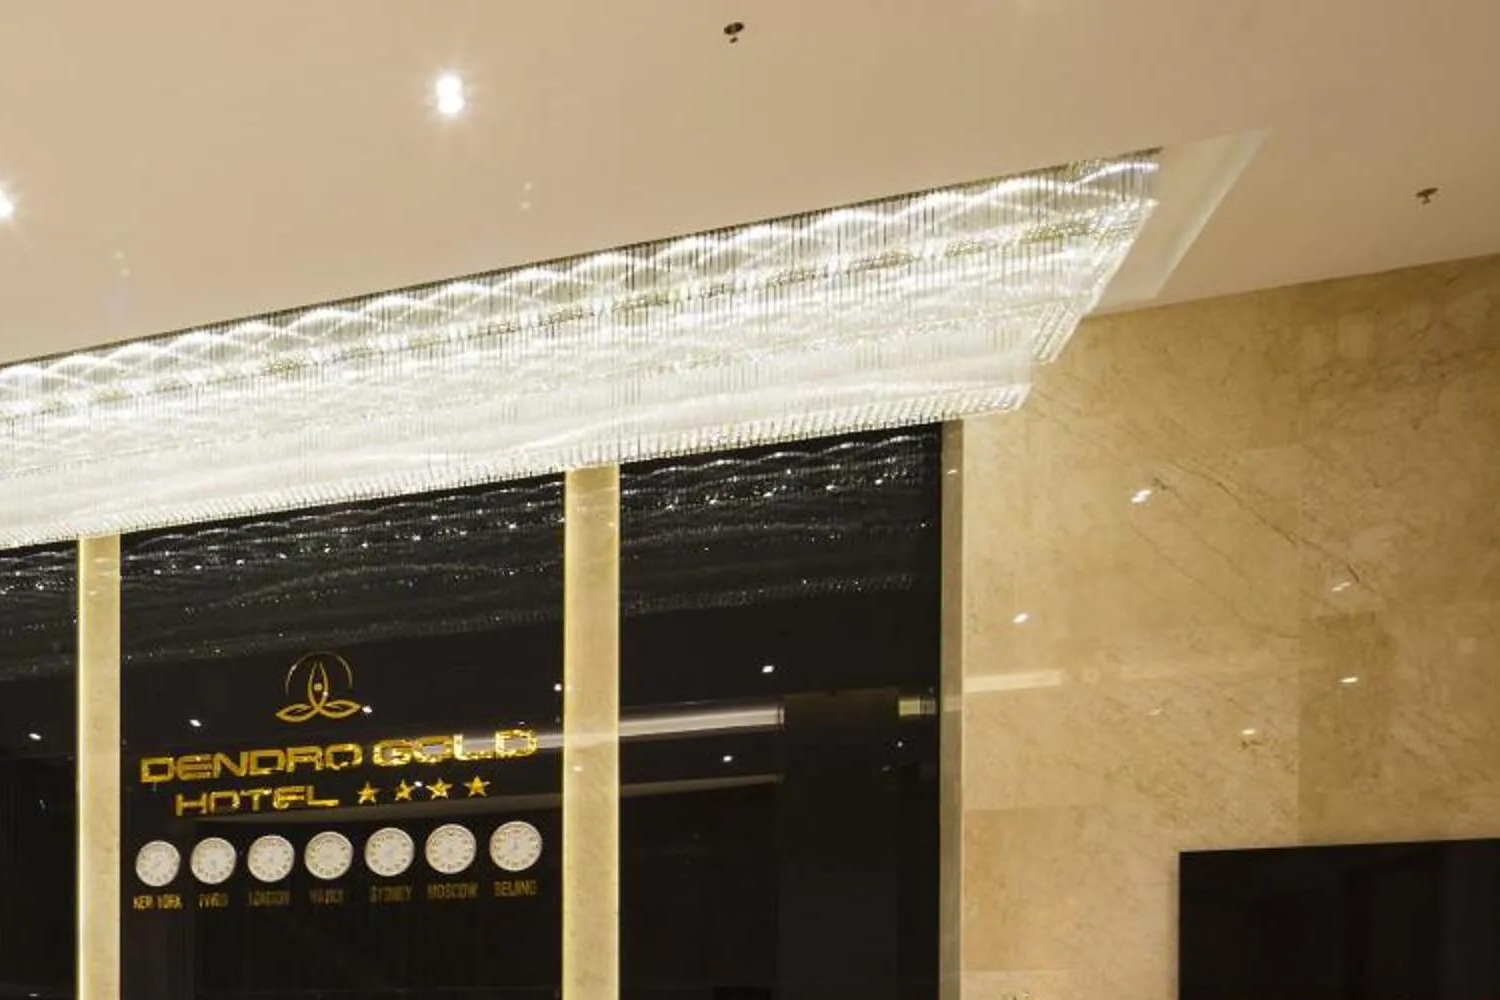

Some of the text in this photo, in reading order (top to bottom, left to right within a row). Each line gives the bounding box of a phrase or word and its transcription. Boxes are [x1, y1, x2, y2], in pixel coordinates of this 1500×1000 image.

[140, 729, 538, 783] DENDRO GOLD
[175, 785, 339, 816] HOTEL
[426, 882, 479, 900] MOSCOW
